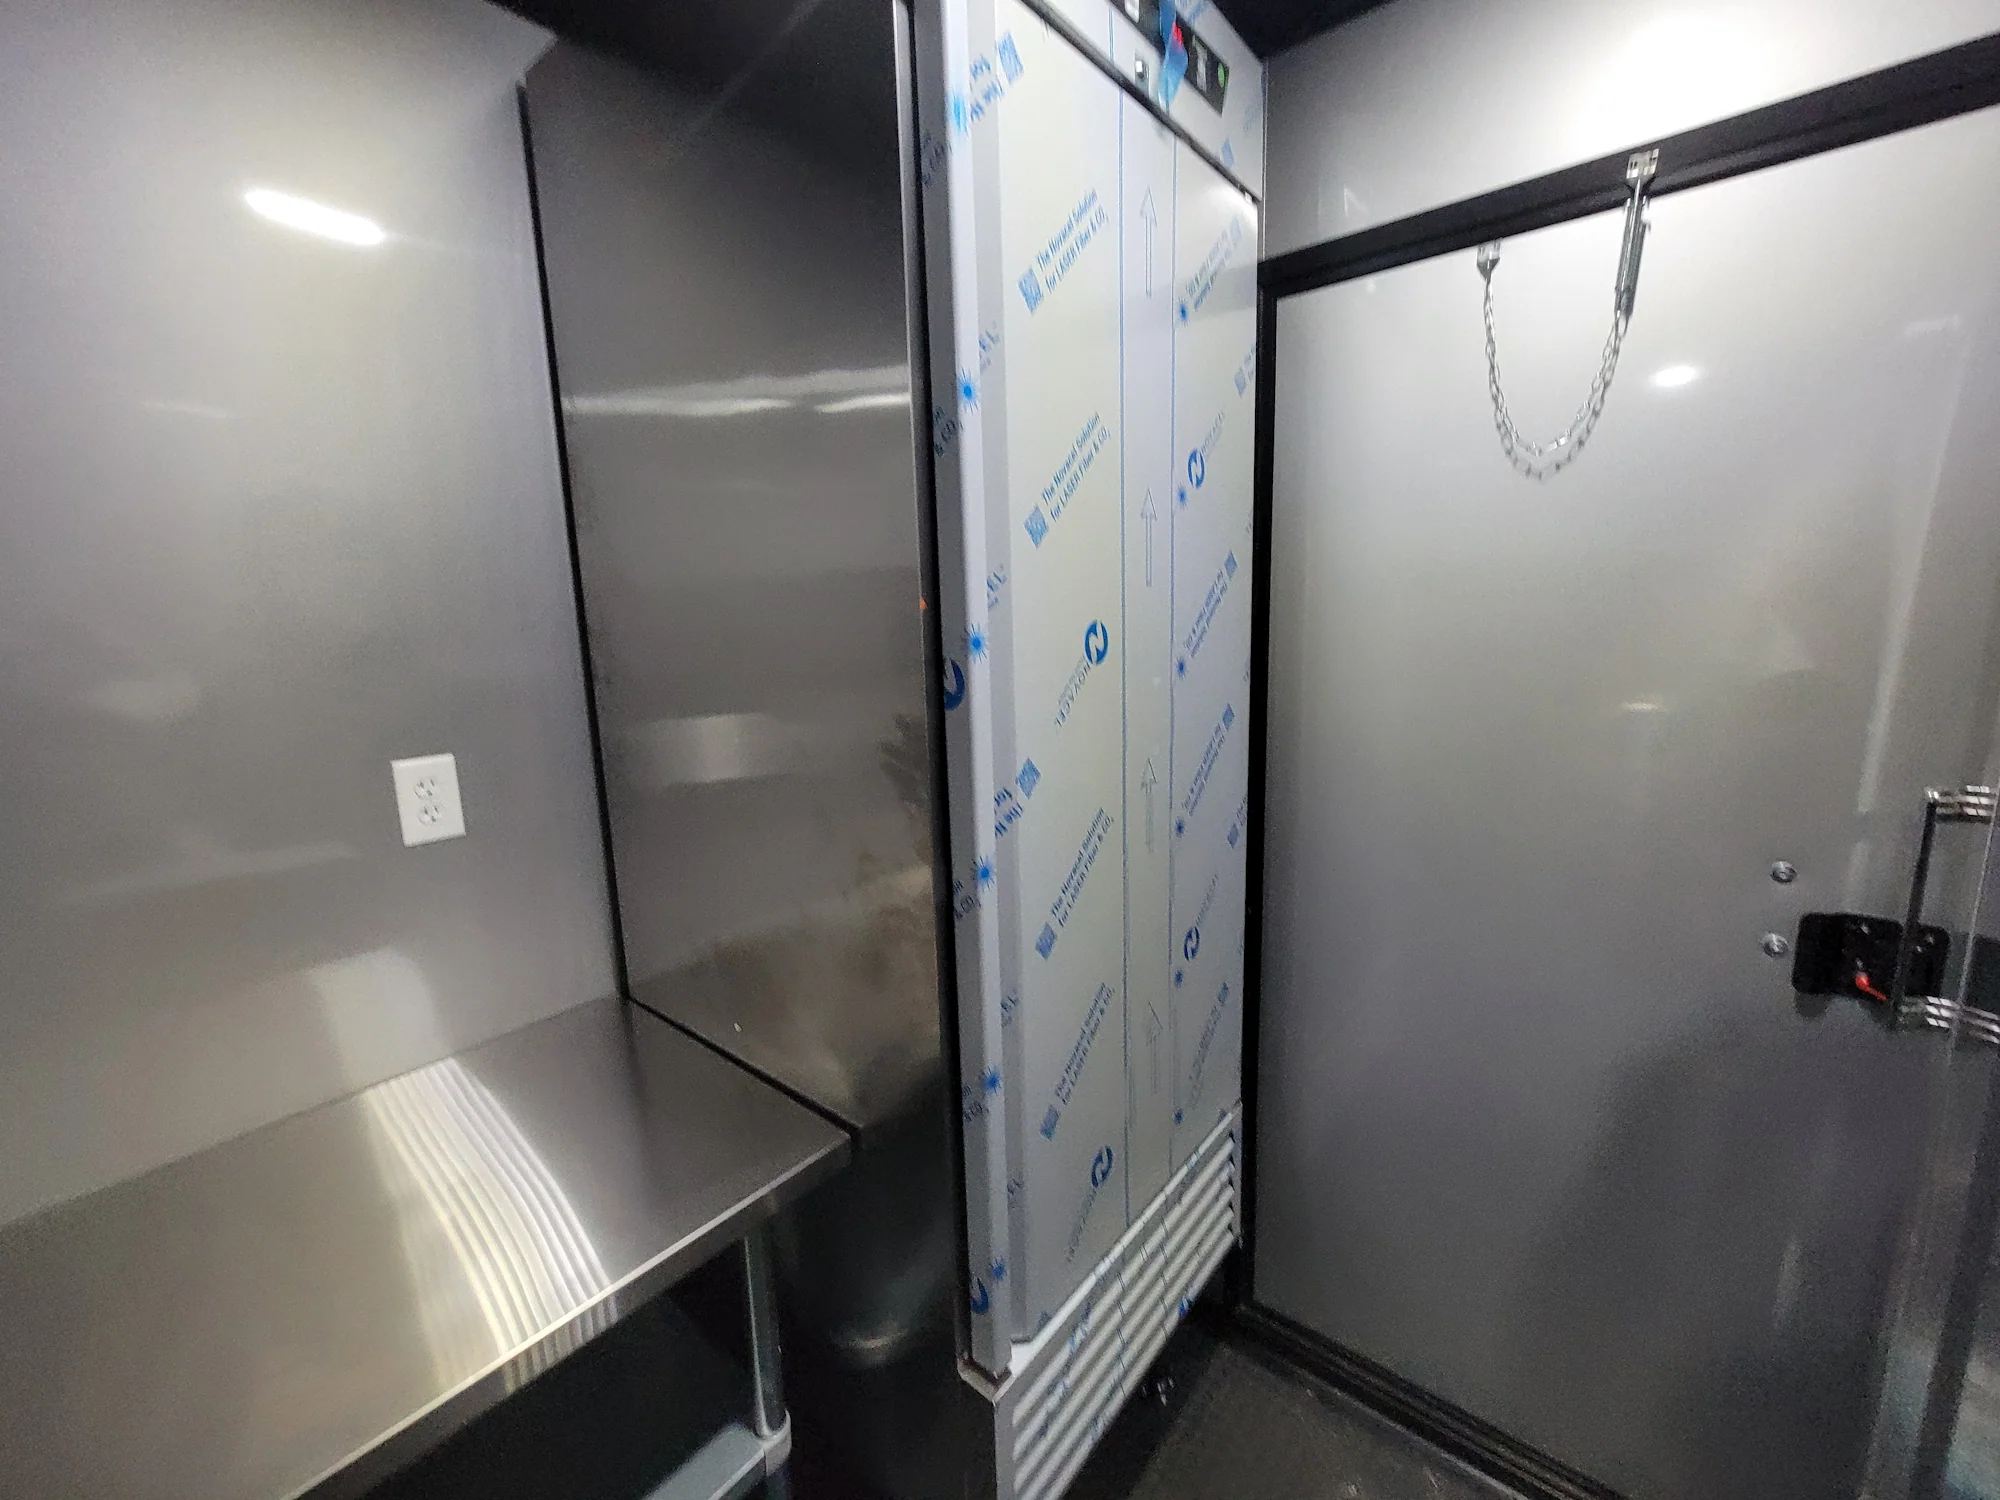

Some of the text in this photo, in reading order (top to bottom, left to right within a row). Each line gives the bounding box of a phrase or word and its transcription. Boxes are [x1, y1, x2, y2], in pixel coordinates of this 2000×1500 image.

[1042, 483, 1055, 505] The
[1053, 443, 1078, 487] Novacel
[1050, 504, 1061, 523] for
